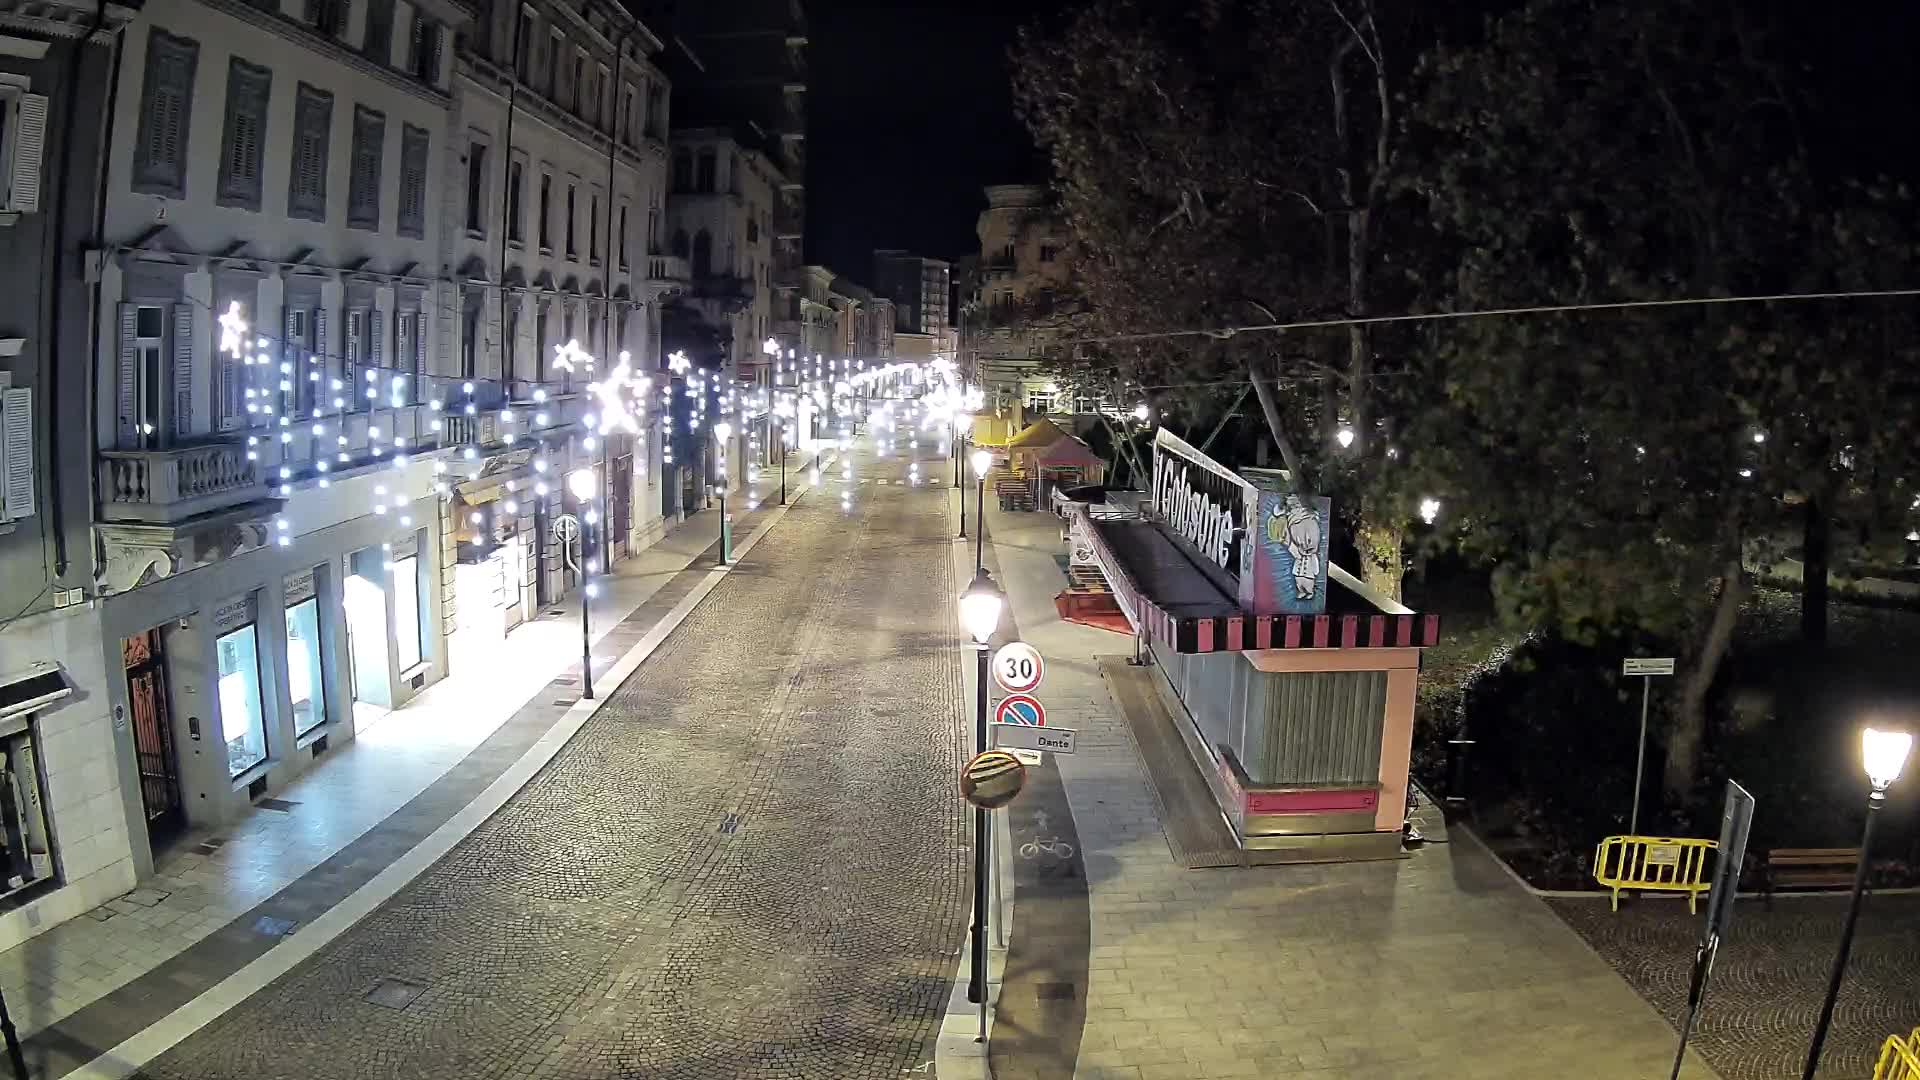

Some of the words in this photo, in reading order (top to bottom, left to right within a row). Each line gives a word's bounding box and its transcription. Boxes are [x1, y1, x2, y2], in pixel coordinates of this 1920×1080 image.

[1162, 457, 1233, 569] Golosone
[1005, 658, 1032, 679] 30
[1038, 737, 1069, 748] Dante
